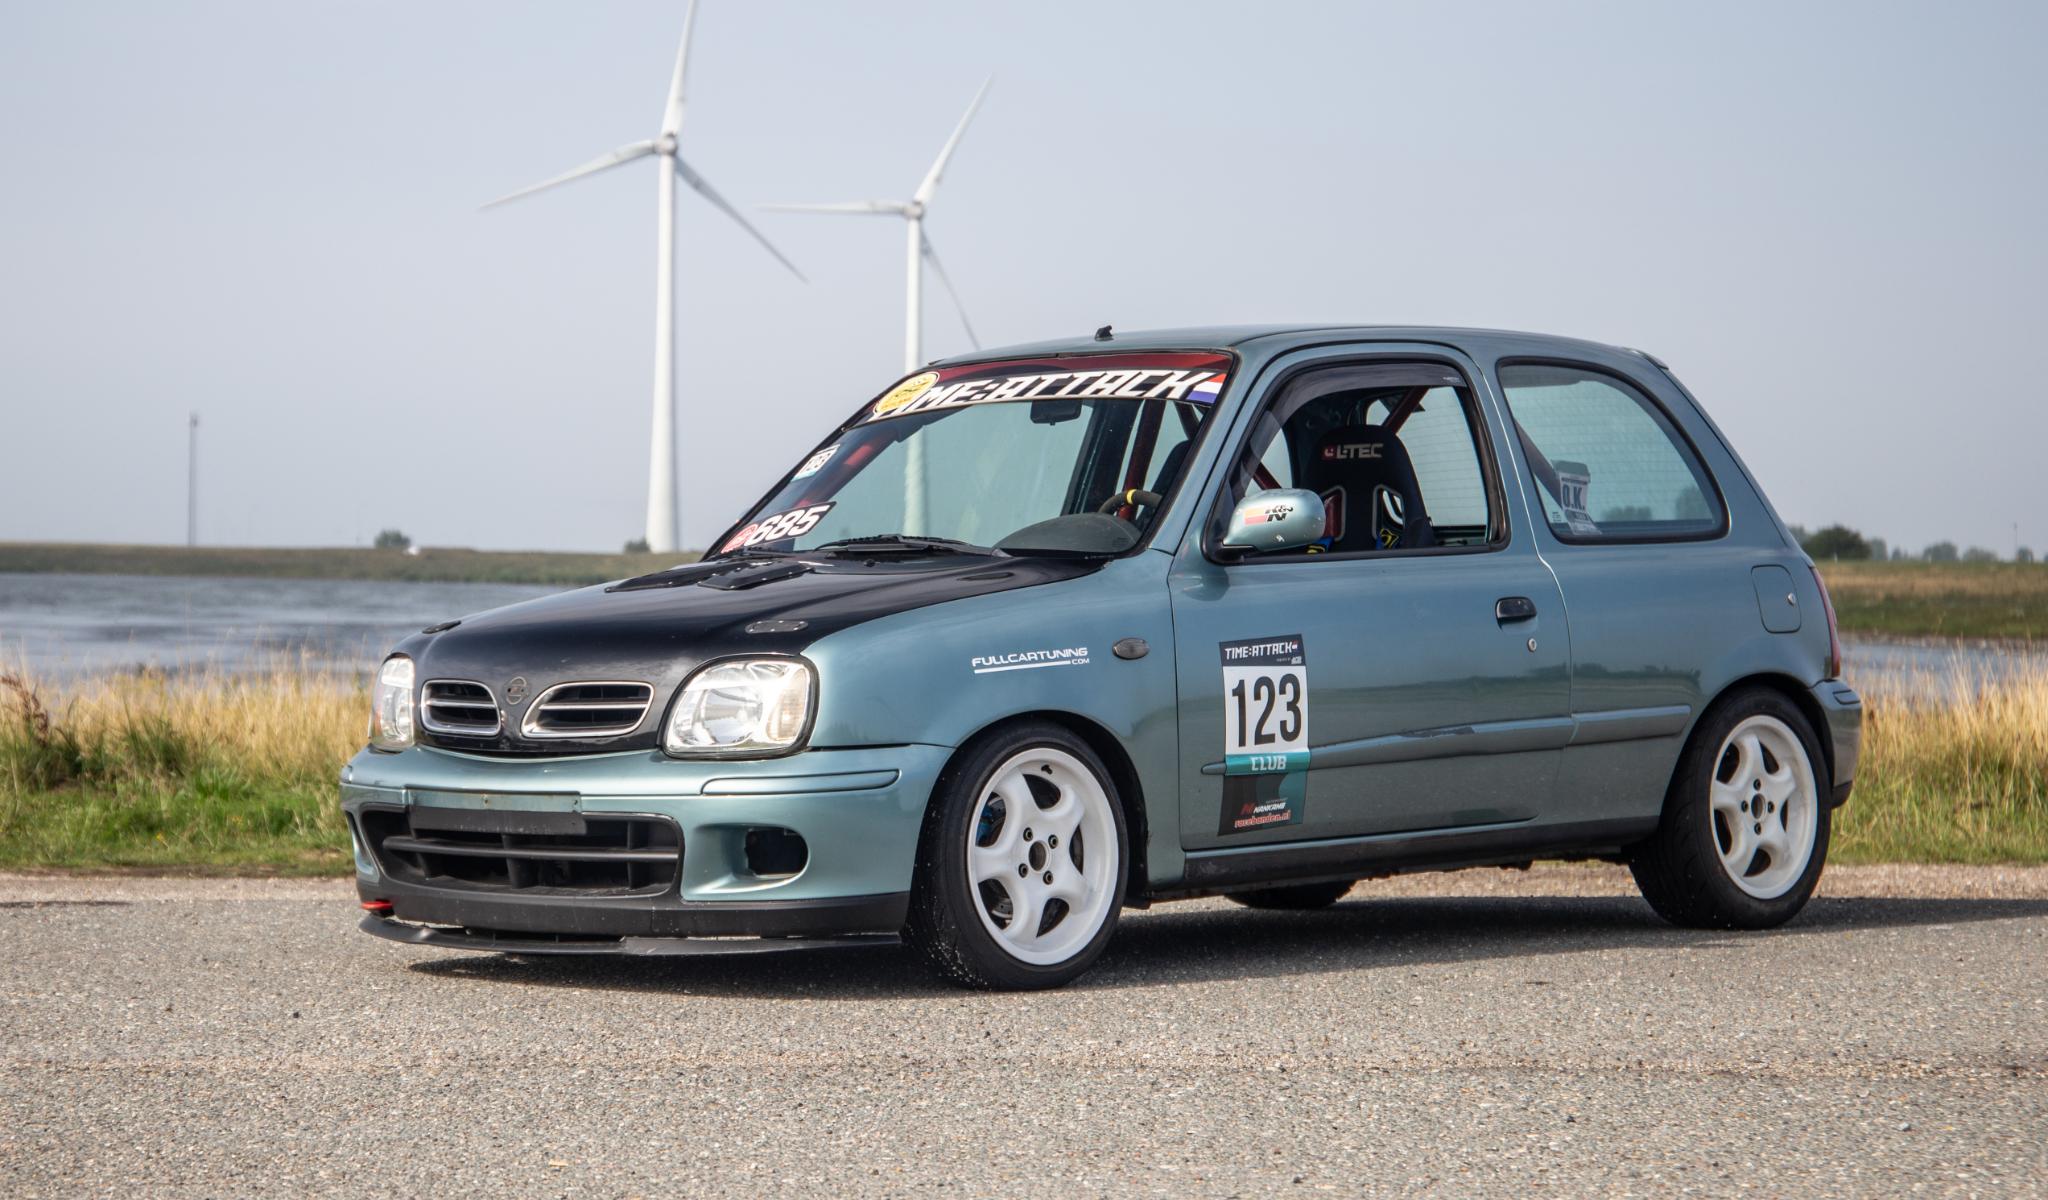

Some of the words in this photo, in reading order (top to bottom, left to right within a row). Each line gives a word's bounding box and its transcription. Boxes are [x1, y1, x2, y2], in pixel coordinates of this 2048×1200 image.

[743, 504, 832, 547] 685
[971, 647, 1088, 667] FULLCARTUNING
[1224, 641, 1293, 660] TIME:ATTACK
[1231, 673, 1302, 748] 123
[1250, 755, 1288, 771] CLUB
